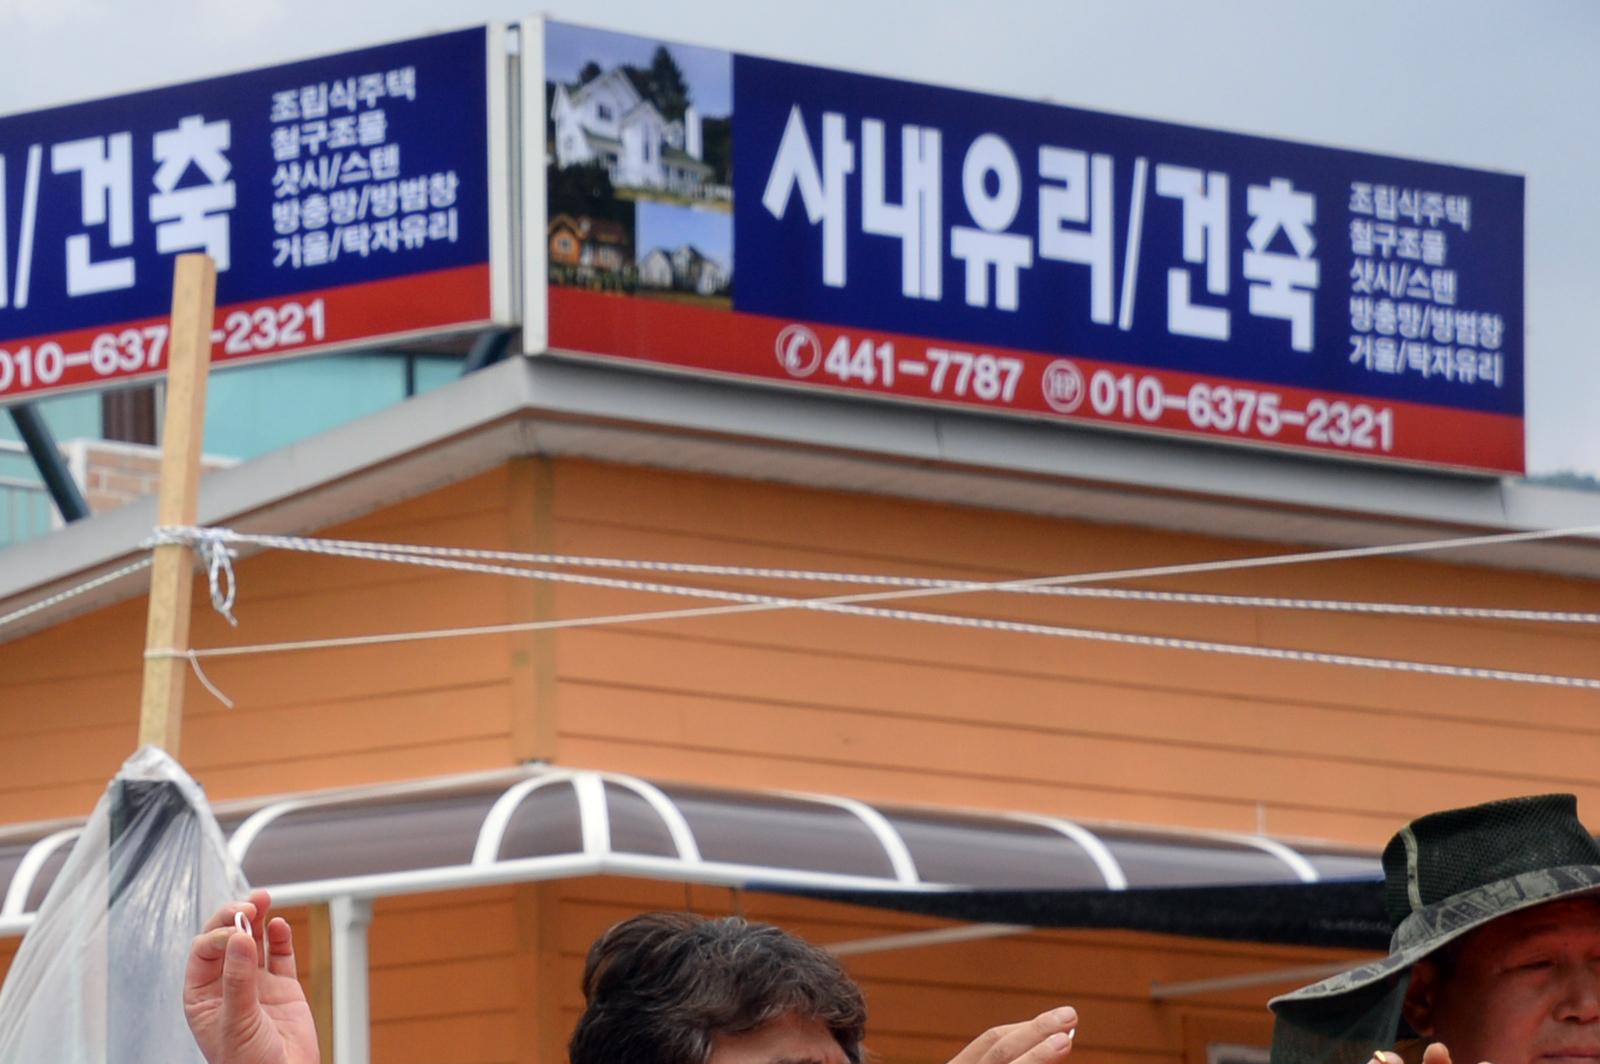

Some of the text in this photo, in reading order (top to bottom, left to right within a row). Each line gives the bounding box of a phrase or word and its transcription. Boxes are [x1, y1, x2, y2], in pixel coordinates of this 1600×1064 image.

[270, 66, 416, 123] 조립식주택
[271, 109, 388, 162] 철구조물
[272, 170, 460, 235] 방충망/방범창
[760, 103, 1320, 352] 사내유리/건축
[1349, 181, 1471, 232] 조립식주택
[272, 207, 458, 269] 거울/탁자유리
[1349, 218, 1447, 266] 철구조물
[1349, 295, 1505, 350] 방충망/방범창
[1349, 335, 1504, 388] 거울/탁자유리
[824, 335, 1024, 402] 441-7787
[1090, 371, 1393, 451] 010-6375-2321
